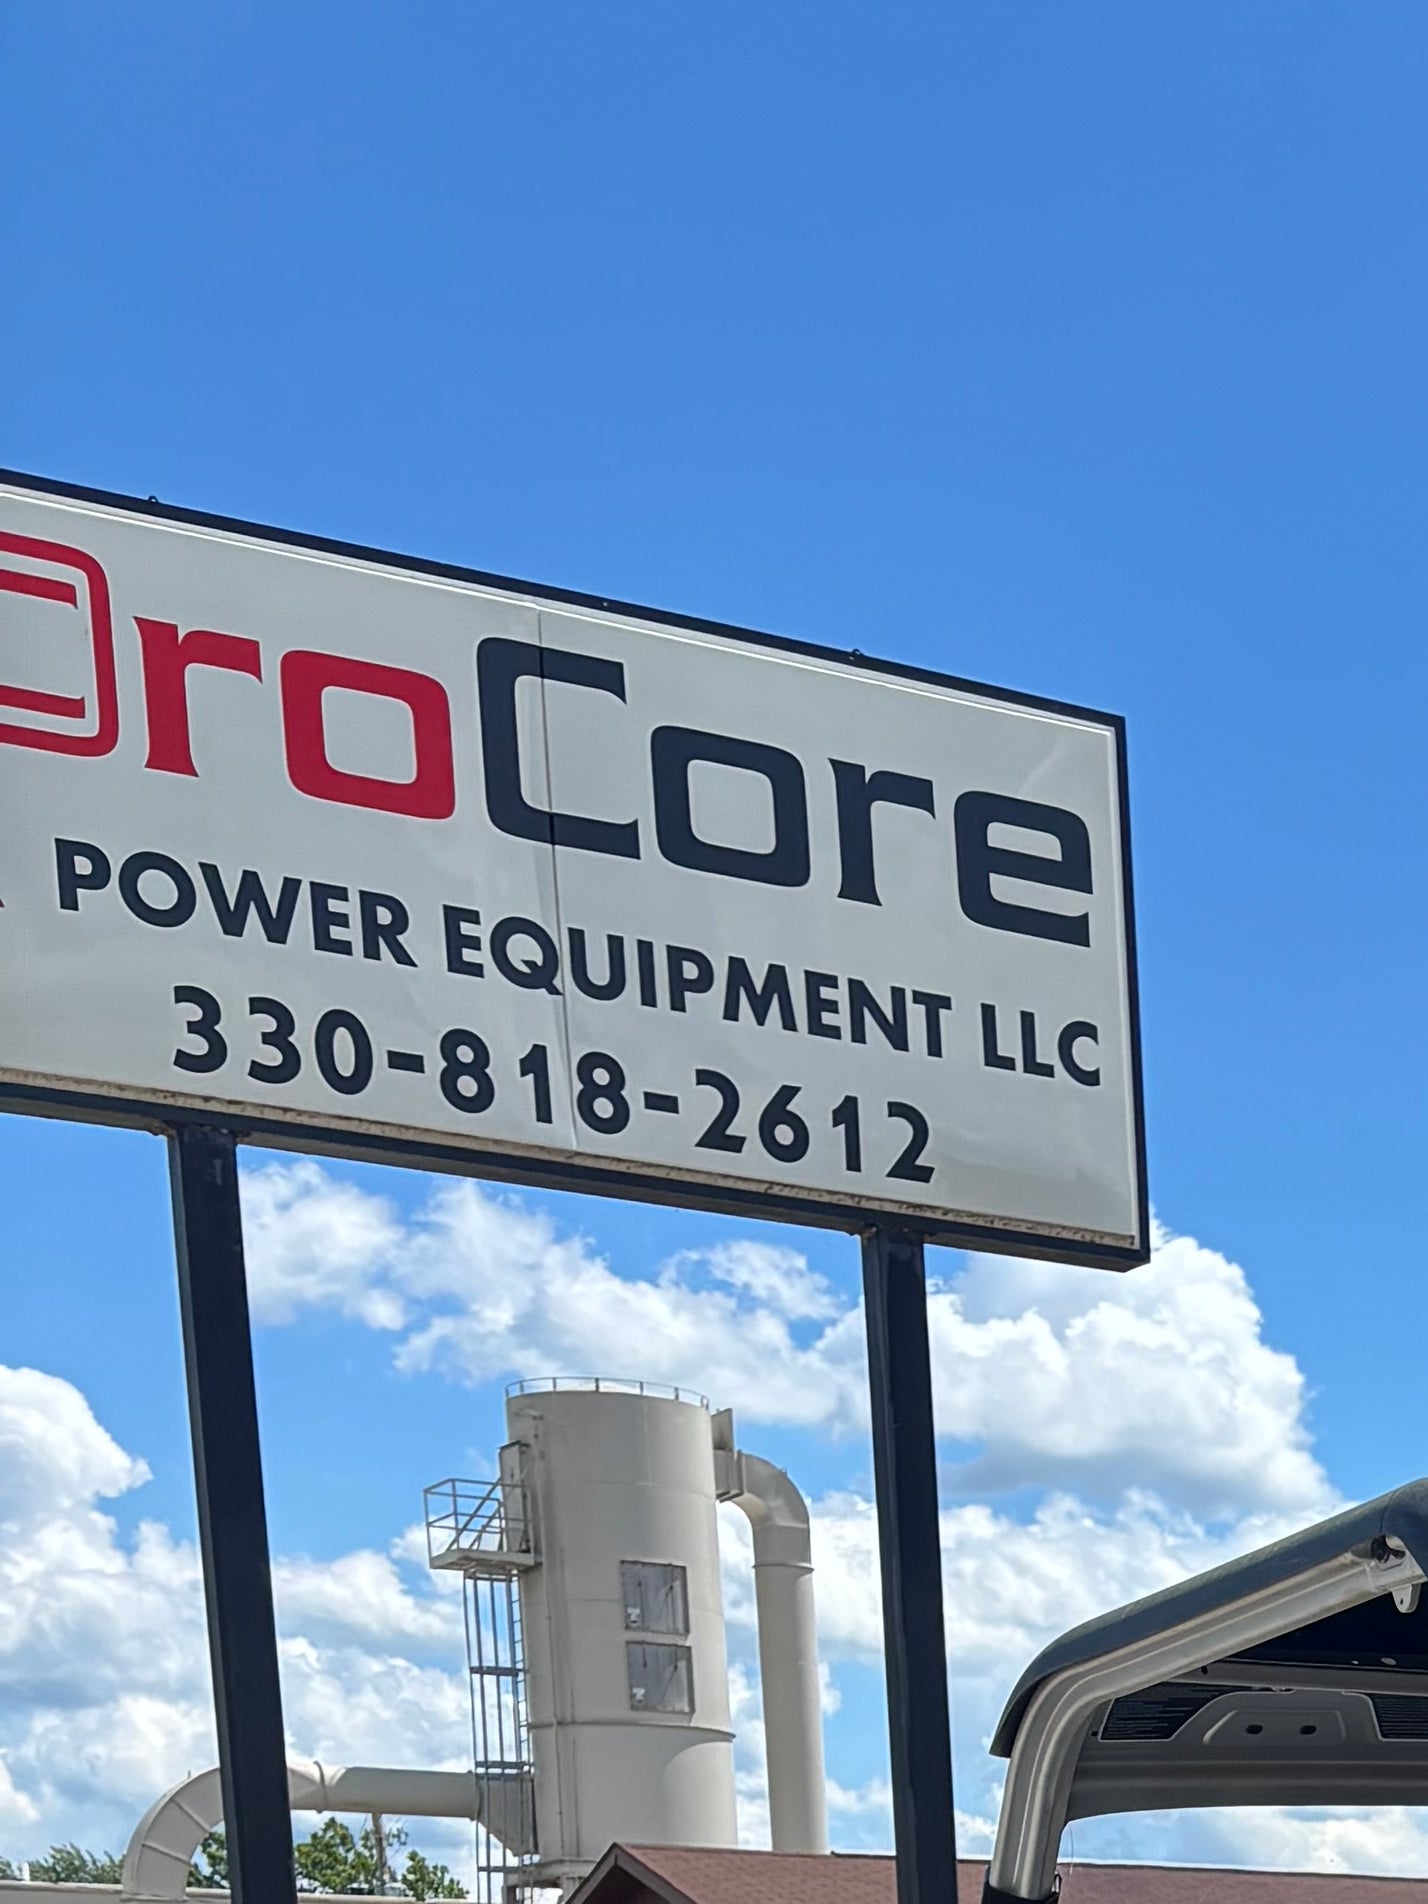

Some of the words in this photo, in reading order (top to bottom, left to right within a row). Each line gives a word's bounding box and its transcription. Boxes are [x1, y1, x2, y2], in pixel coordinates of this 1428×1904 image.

[54, 837, 419, 968] POWER
[442, 903, 953, 1059] EQUIPMENT
[980, 1002, 1101, 1087] LLC
[172, 985, 936, 1184] 330-818-2612
